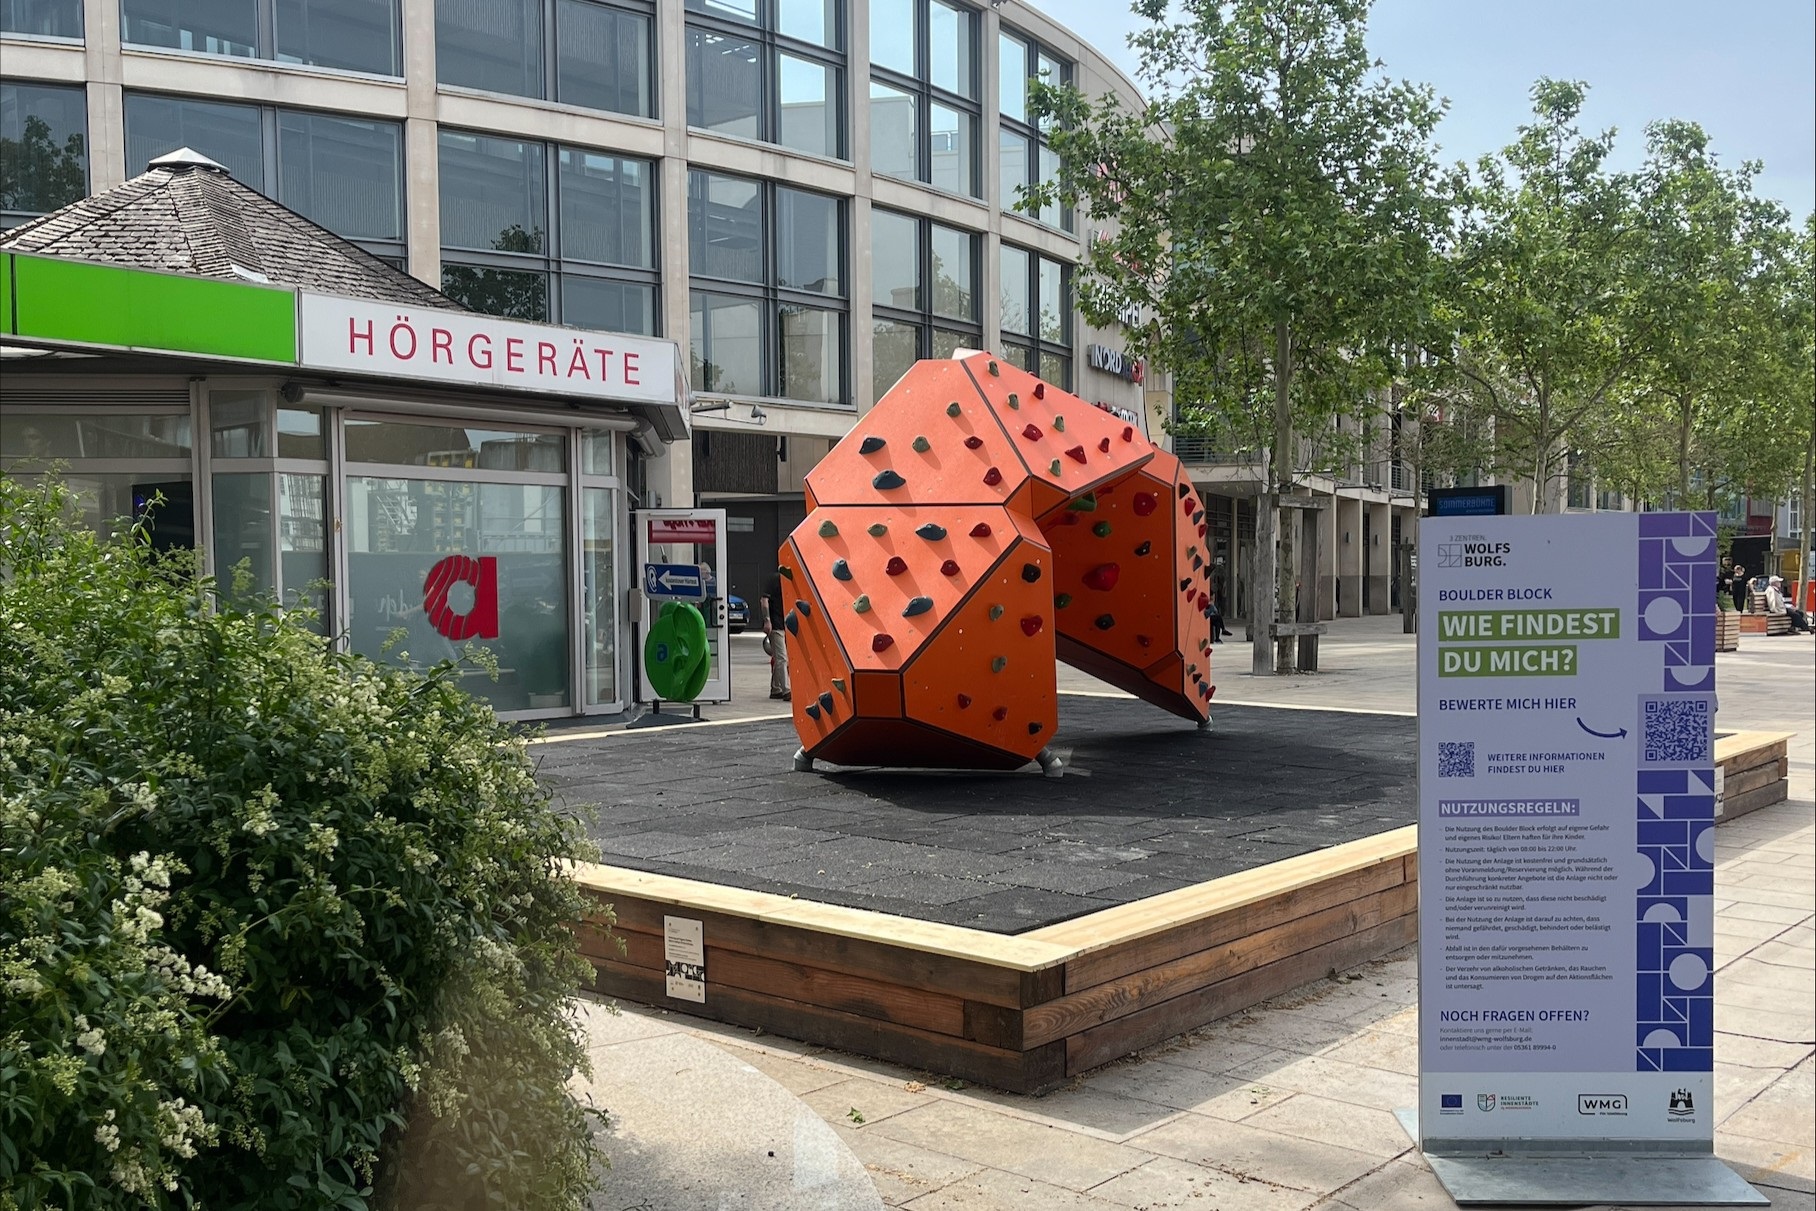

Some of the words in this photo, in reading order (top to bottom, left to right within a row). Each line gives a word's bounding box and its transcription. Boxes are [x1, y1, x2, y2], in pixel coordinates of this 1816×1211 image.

[349, 316, 640, 385] HÖRGERÄTE
[1464, 542, 1510, 554] WOLFS
[1464, 556, 1506, 566] BURG.
[1440, 590, 1504, 602] BOULDER
[1508, 588, 1552, 600] BLOCK
[1442, 614, 1492, 636] WIE
[1500, 612, 1616, 636] FINDEST
[1444, 652, 1480, 672] DU
[1490, 648, 1574, 672] MICH?
[1440, 698, 1502, 710] BEWERTE
[1506, 698, 1540, 710] MICH
[1544, 698, 1576, 710] HIER
[1488, 754, 1526, 762] WEITERE
[1530, 752, 1604, 760] INFORMATIONEN
[1488, 766, 1526, 774] FINDEST
[1528, 766, 1540, 774] DU
[1544, 764, 1564, 772] HIER
[1442, 802, 1576, 814] NUTZUNGSREGELN:
[1456, 825, 1481, 834] Nutzung
[1536, 825, 1557, 833] erfolgt
[1568, 824, 1588, 833] eigene
[1458, 834, 1481, 842] eigenes
[1486, 845, 1507, 854] täglich
[1456, 857, 1482, 866] Nutzung
[1493, 857, 1514, 865] Anlage
[1567, 856, 1608, 865] grundsätzlich
[1461, 866, 1547, 874] Voranmeldung/Reservierung
[1548, 865, 1573, 874] möglich.
[1445, 875, 1487, 883] Durchführung
[1517, 874, 1546, 883] Angebote
[1566, 874, 1586, 882] Anlage
[1456, 883, 1498, 891] eingeschränkt
[1456, 896, 1476, 904] Anlage
[1502, 896, 1524, 904] nutzen,
[1573, 895, 1607, 904] beschädigt
[1445, 904, 1473, 912] und/oder
[1474, 904, 1510, 912] verunreinigt
[1466, 916, 1492, 924] Nutzung
[1504, 915, 1525, 924] Anlage
[1563, 915, 1585, 923] achten,
[1472, 924, 1503, 932] gefährdet,
[1504, 924, 1538, 932] geschädigt,
[1584, 924, 1611, 932] belästigt
[1508, 944, 1550, 953] vorgesehenen
[1445, 954, 1475, 962] entsorgen
[1534, 964, 1567, 973] Getränken,
[1522, 973, 1544, 982] Drogen
[1453, 982, 1483, 990] untersagt.
[1440, 1010, 1478, 1022] NOCH
[1482, 1010, 1534, 1022] FRAGEN
[1538, 1010, 1590, 1022] OFFEN?
[1584, 1100, 1620, 1110] WMG
